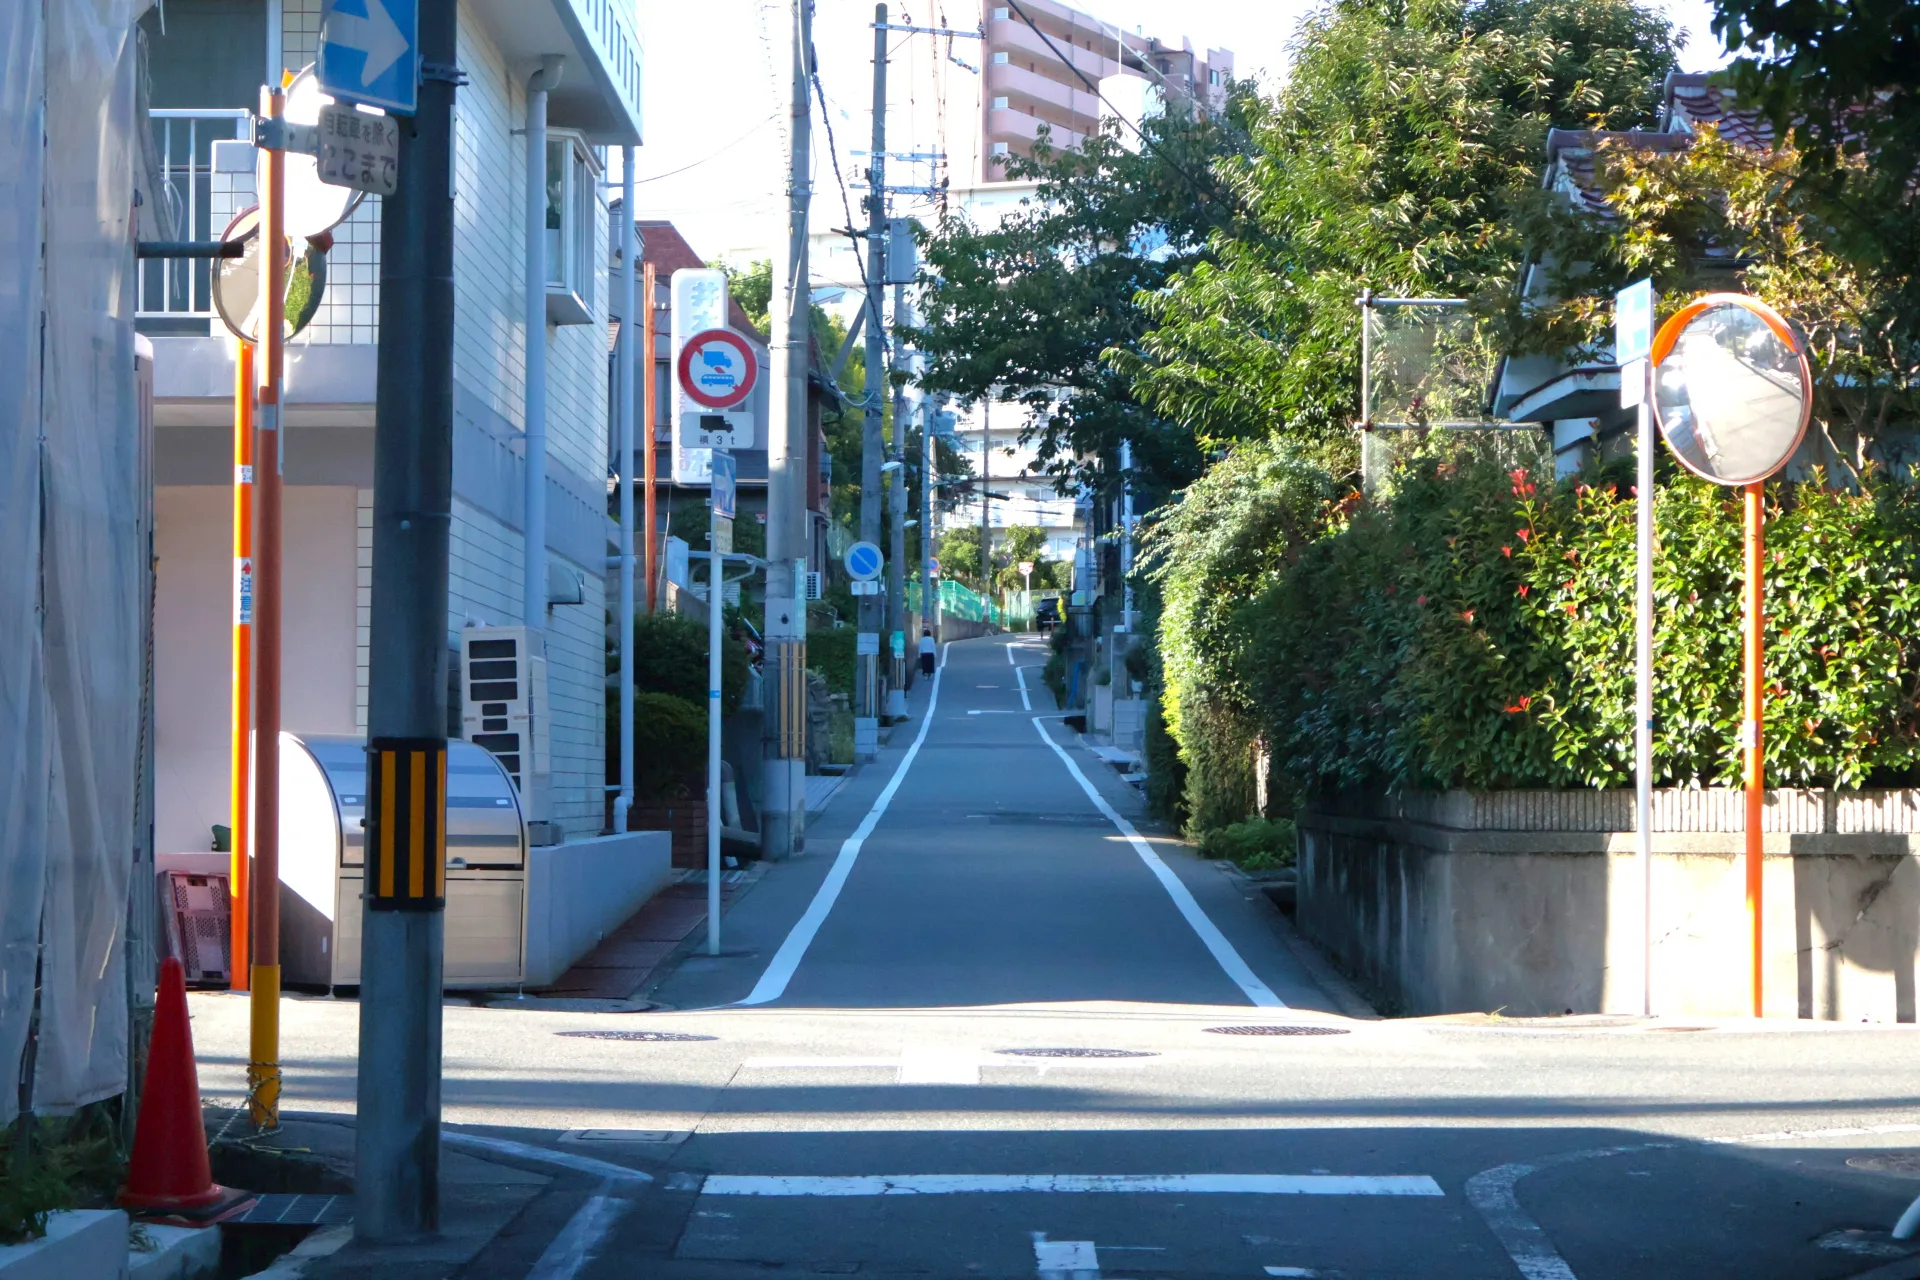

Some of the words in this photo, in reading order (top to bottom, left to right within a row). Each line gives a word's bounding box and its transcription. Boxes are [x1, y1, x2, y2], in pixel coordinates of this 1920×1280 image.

[324, 113, 393, 148] 自転車を除く
[324, 146, 396, 189] ここまで
